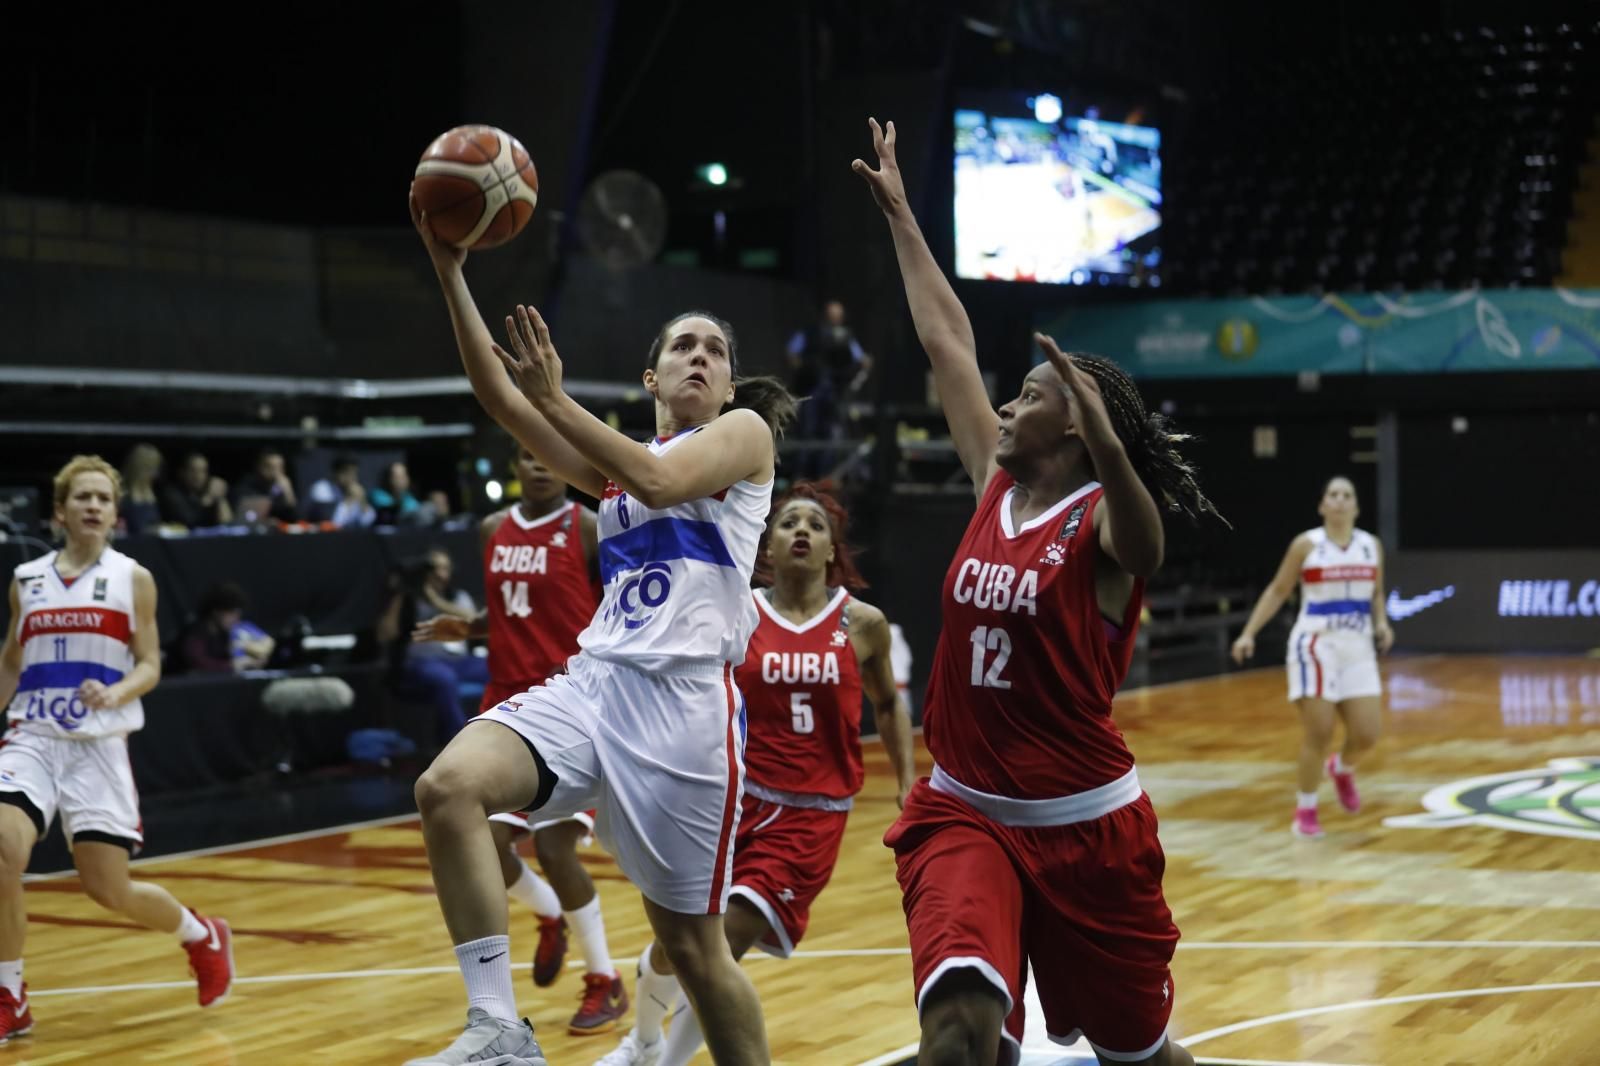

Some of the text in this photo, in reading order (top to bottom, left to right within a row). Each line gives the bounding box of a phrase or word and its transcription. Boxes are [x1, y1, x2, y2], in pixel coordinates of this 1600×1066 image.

[617, 492, 631, 530] 6
[490, 545, 548, 575] CUBA
[500, 580, 533, 618] 14
[953, 557, 1039, 617] CUBA
[29, 612, 103, 630] PARAGUAY
[54, 637, 66, 661] 11
[970, 625, 1011, 689] 12
[762, 651, 840, 686] CUBA
[790, 692, 815, 735] 5
